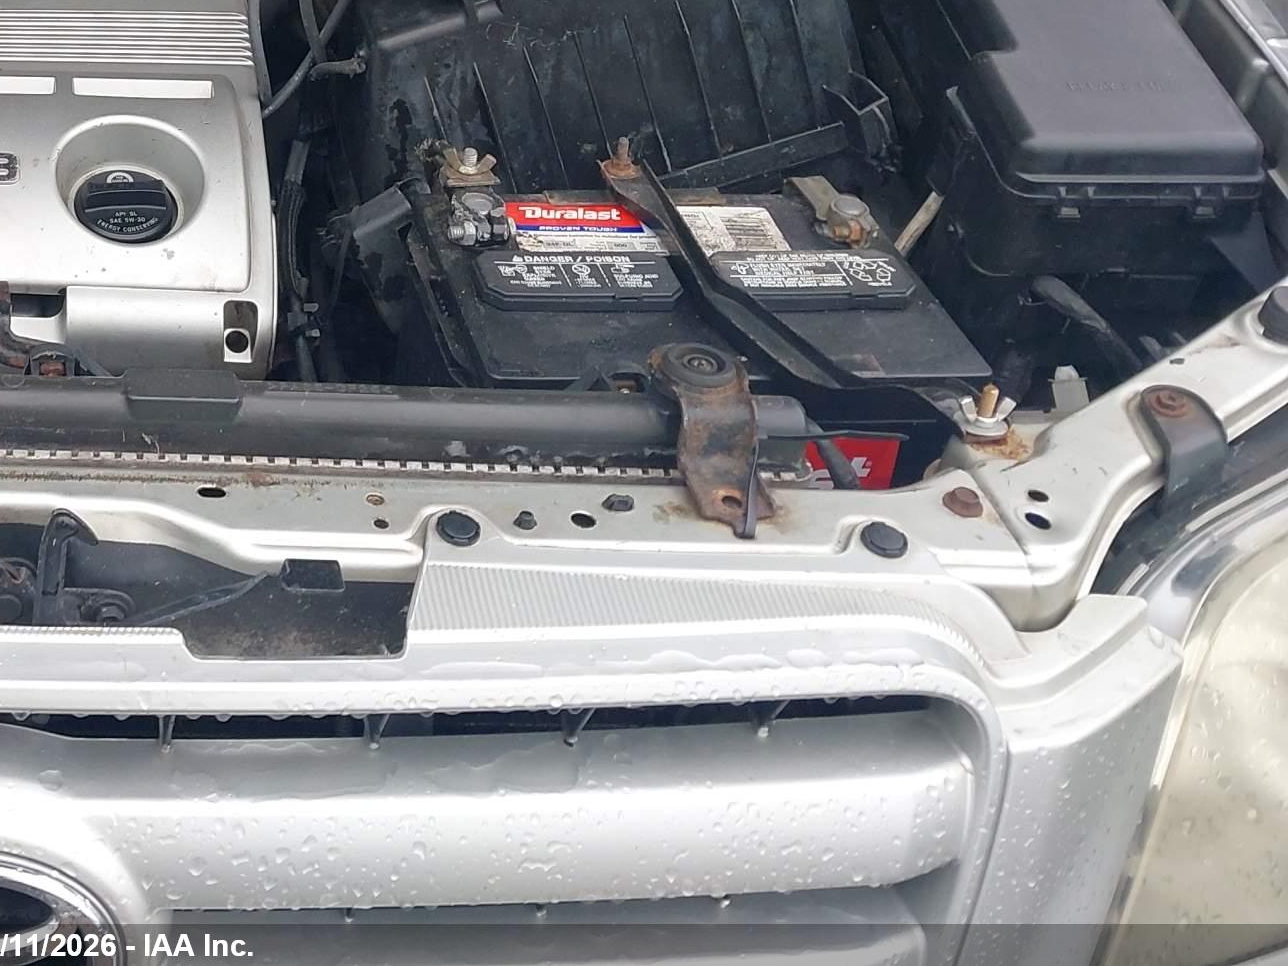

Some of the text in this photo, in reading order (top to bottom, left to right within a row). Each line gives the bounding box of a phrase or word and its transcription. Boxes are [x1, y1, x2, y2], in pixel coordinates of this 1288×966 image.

[519, 206, 621, 220] Duralast
[97, 219, 121, 231] ENERGY
[524, 255, 573, 263] DANGER
[586, 256, 631, 264] POISON
